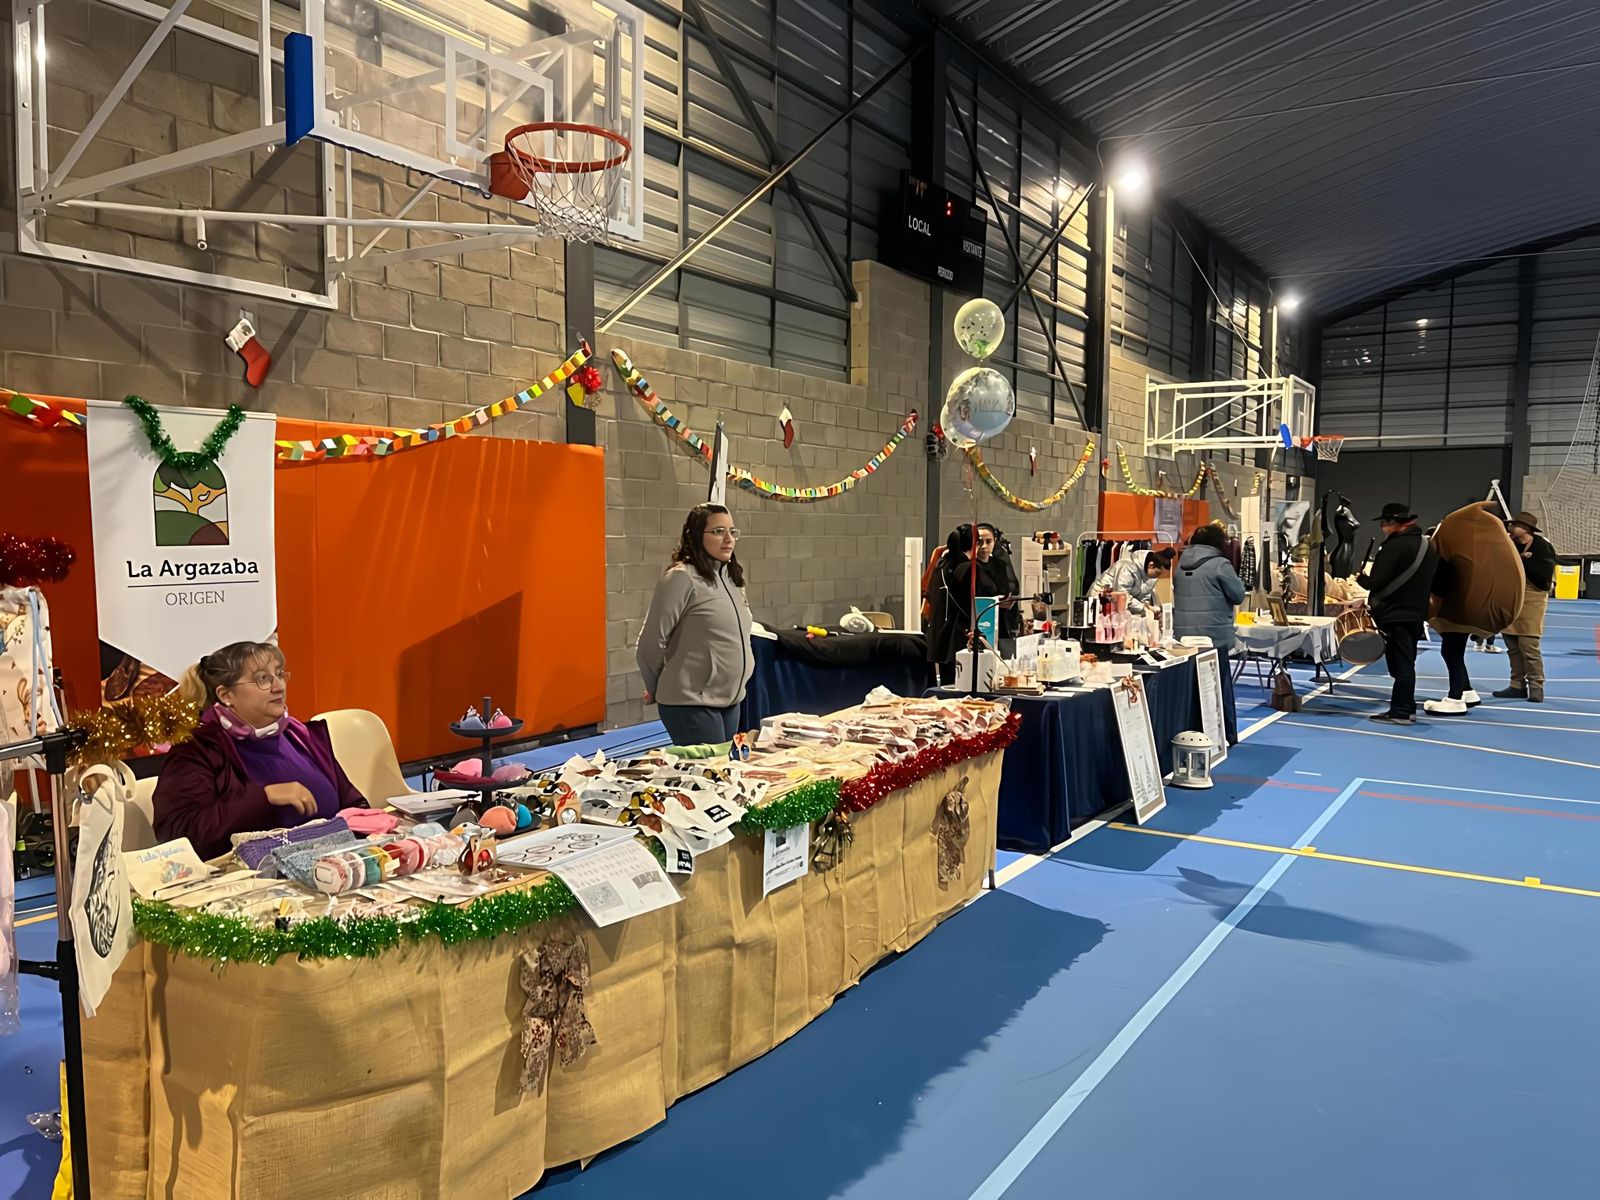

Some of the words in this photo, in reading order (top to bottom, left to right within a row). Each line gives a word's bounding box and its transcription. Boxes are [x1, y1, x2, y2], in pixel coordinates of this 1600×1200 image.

[908, 215, 931, 236] LOCAL
[126, 560, 153, 578] La
[159, 558, 259, 580] Argazaba
[165, 590, 225, 606] ORIGEN
